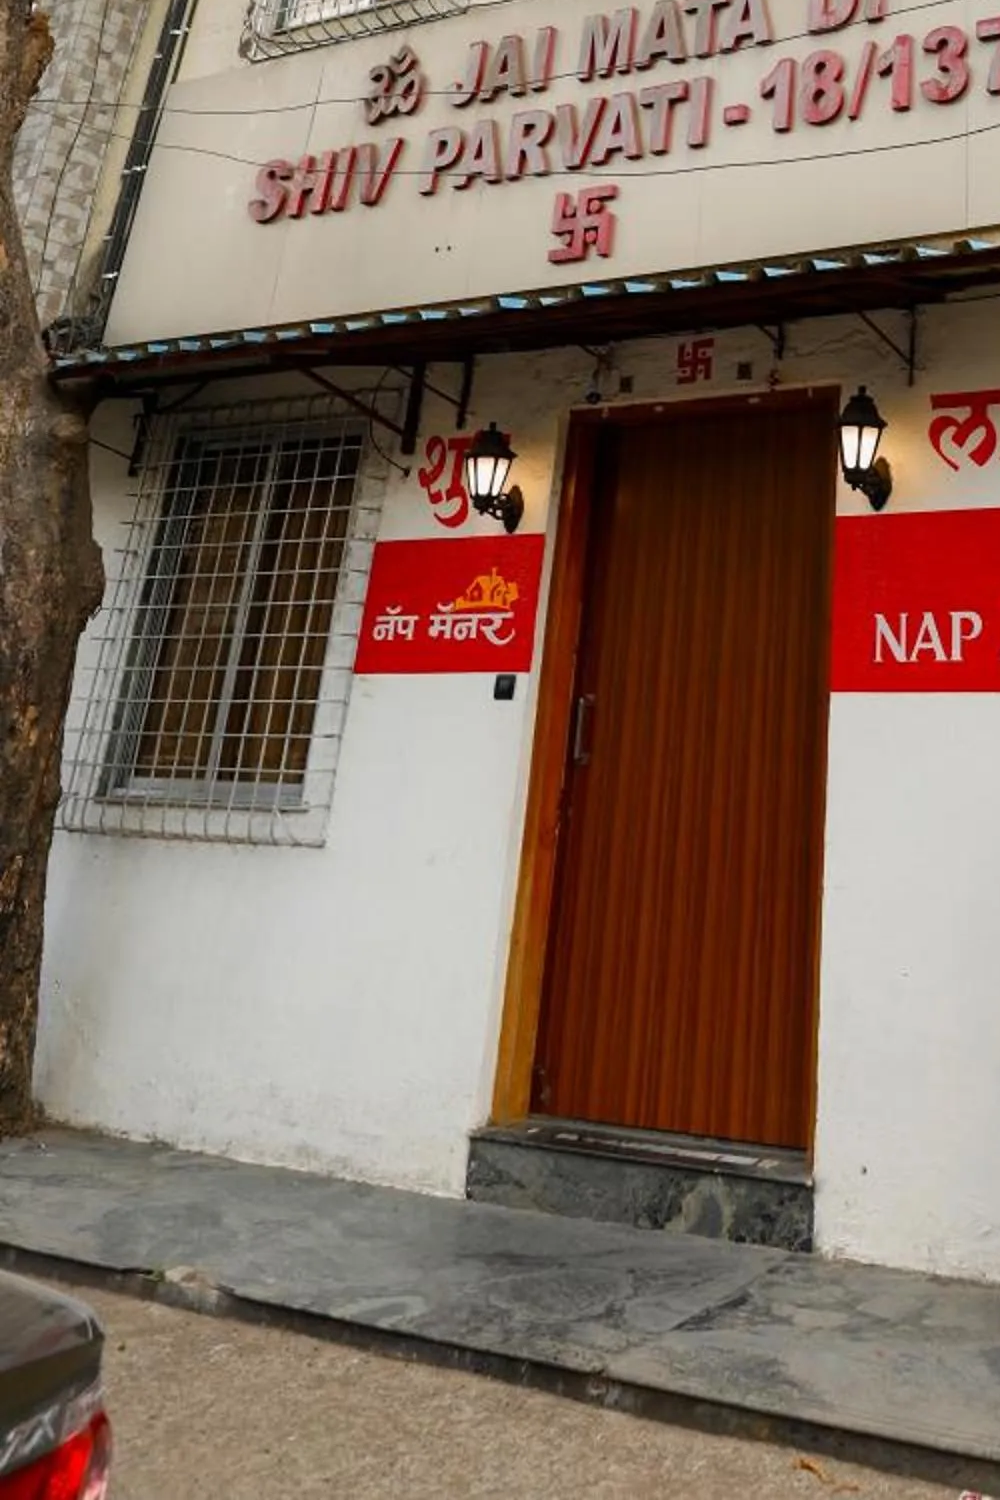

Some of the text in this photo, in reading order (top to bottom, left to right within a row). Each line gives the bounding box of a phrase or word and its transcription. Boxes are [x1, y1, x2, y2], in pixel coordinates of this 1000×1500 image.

[451, 25, 556, 108] JAI
[247, 137, 404, 224] SHIV
[418, 432, 511, 528] शु
[372, 602, 516, 645] नॅप मॅनर
[873, 610, 983, 663] NAP
